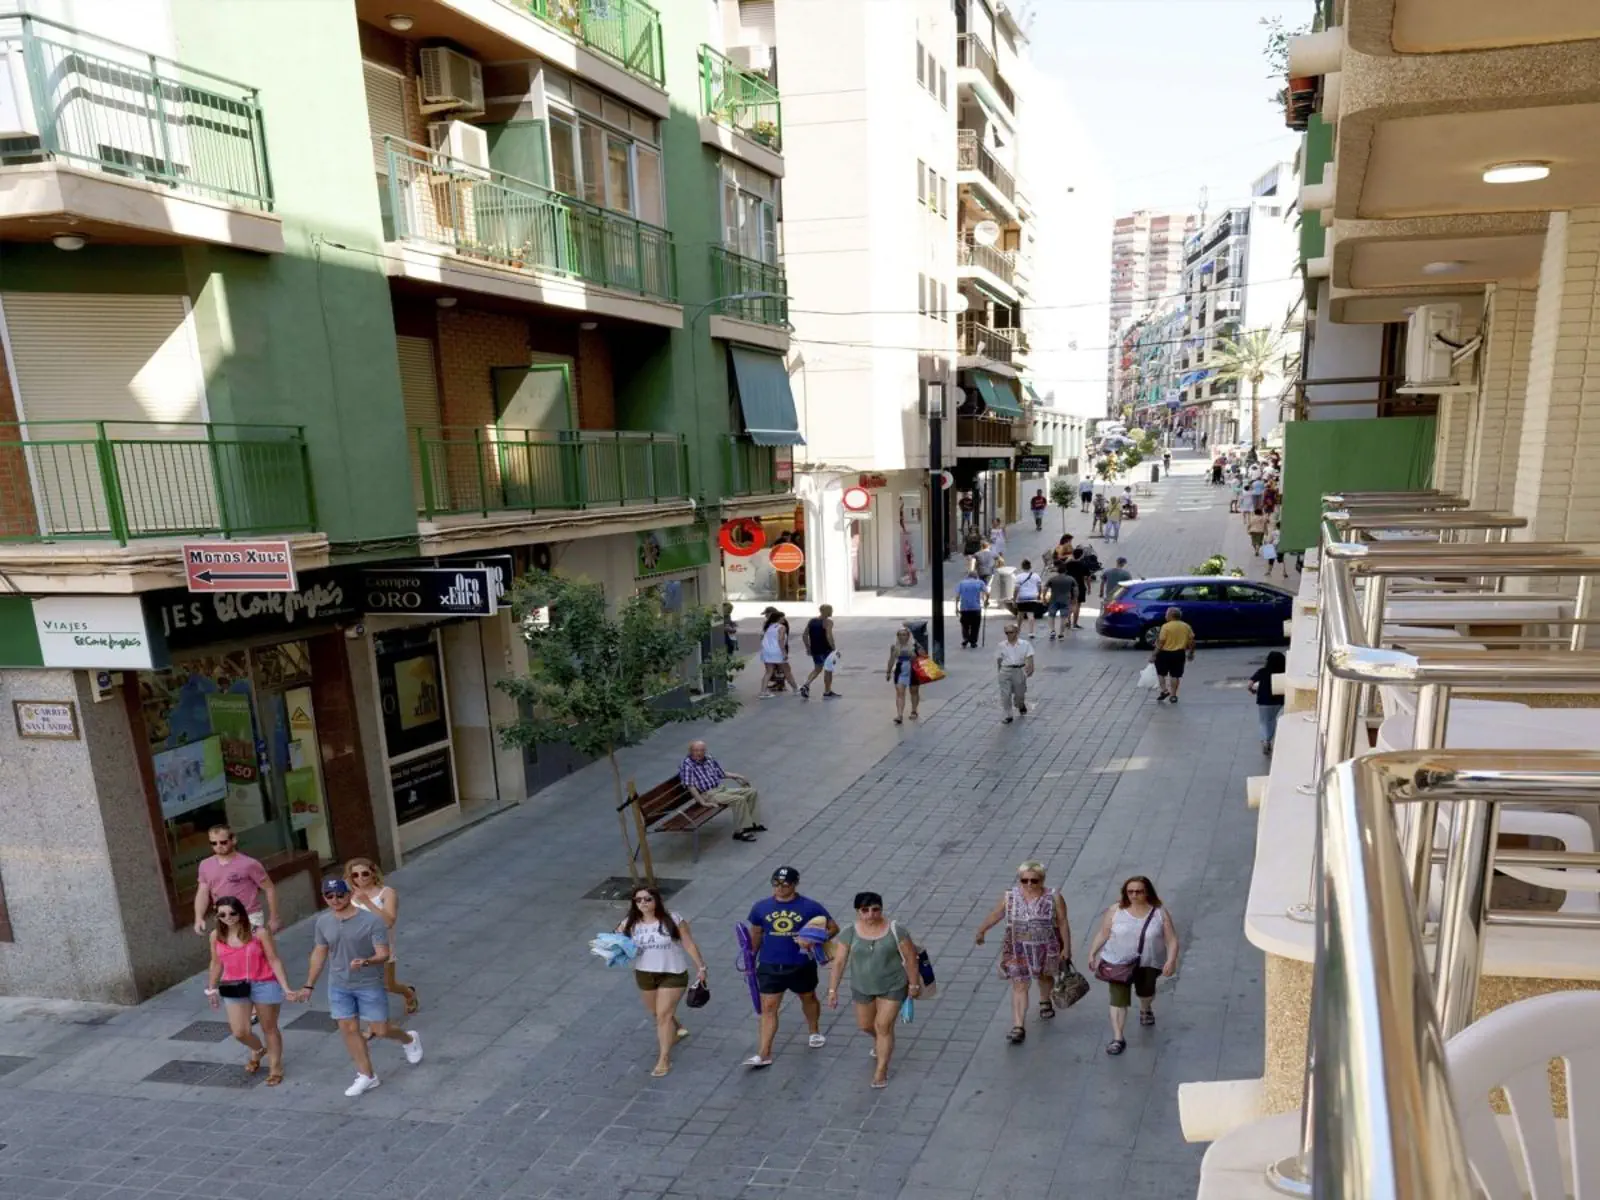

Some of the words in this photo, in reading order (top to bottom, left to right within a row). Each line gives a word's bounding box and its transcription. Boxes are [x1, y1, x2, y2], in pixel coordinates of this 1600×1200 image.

[455, 573, 479, 593] Oro
[368, 591, 421, 608] ORO
[43, 620, 88, 632] VIAJES
[74, 635, 86, 647] El
[85, 635, 108, 647] Corte
[108, 633, 141, 649] Inglés
